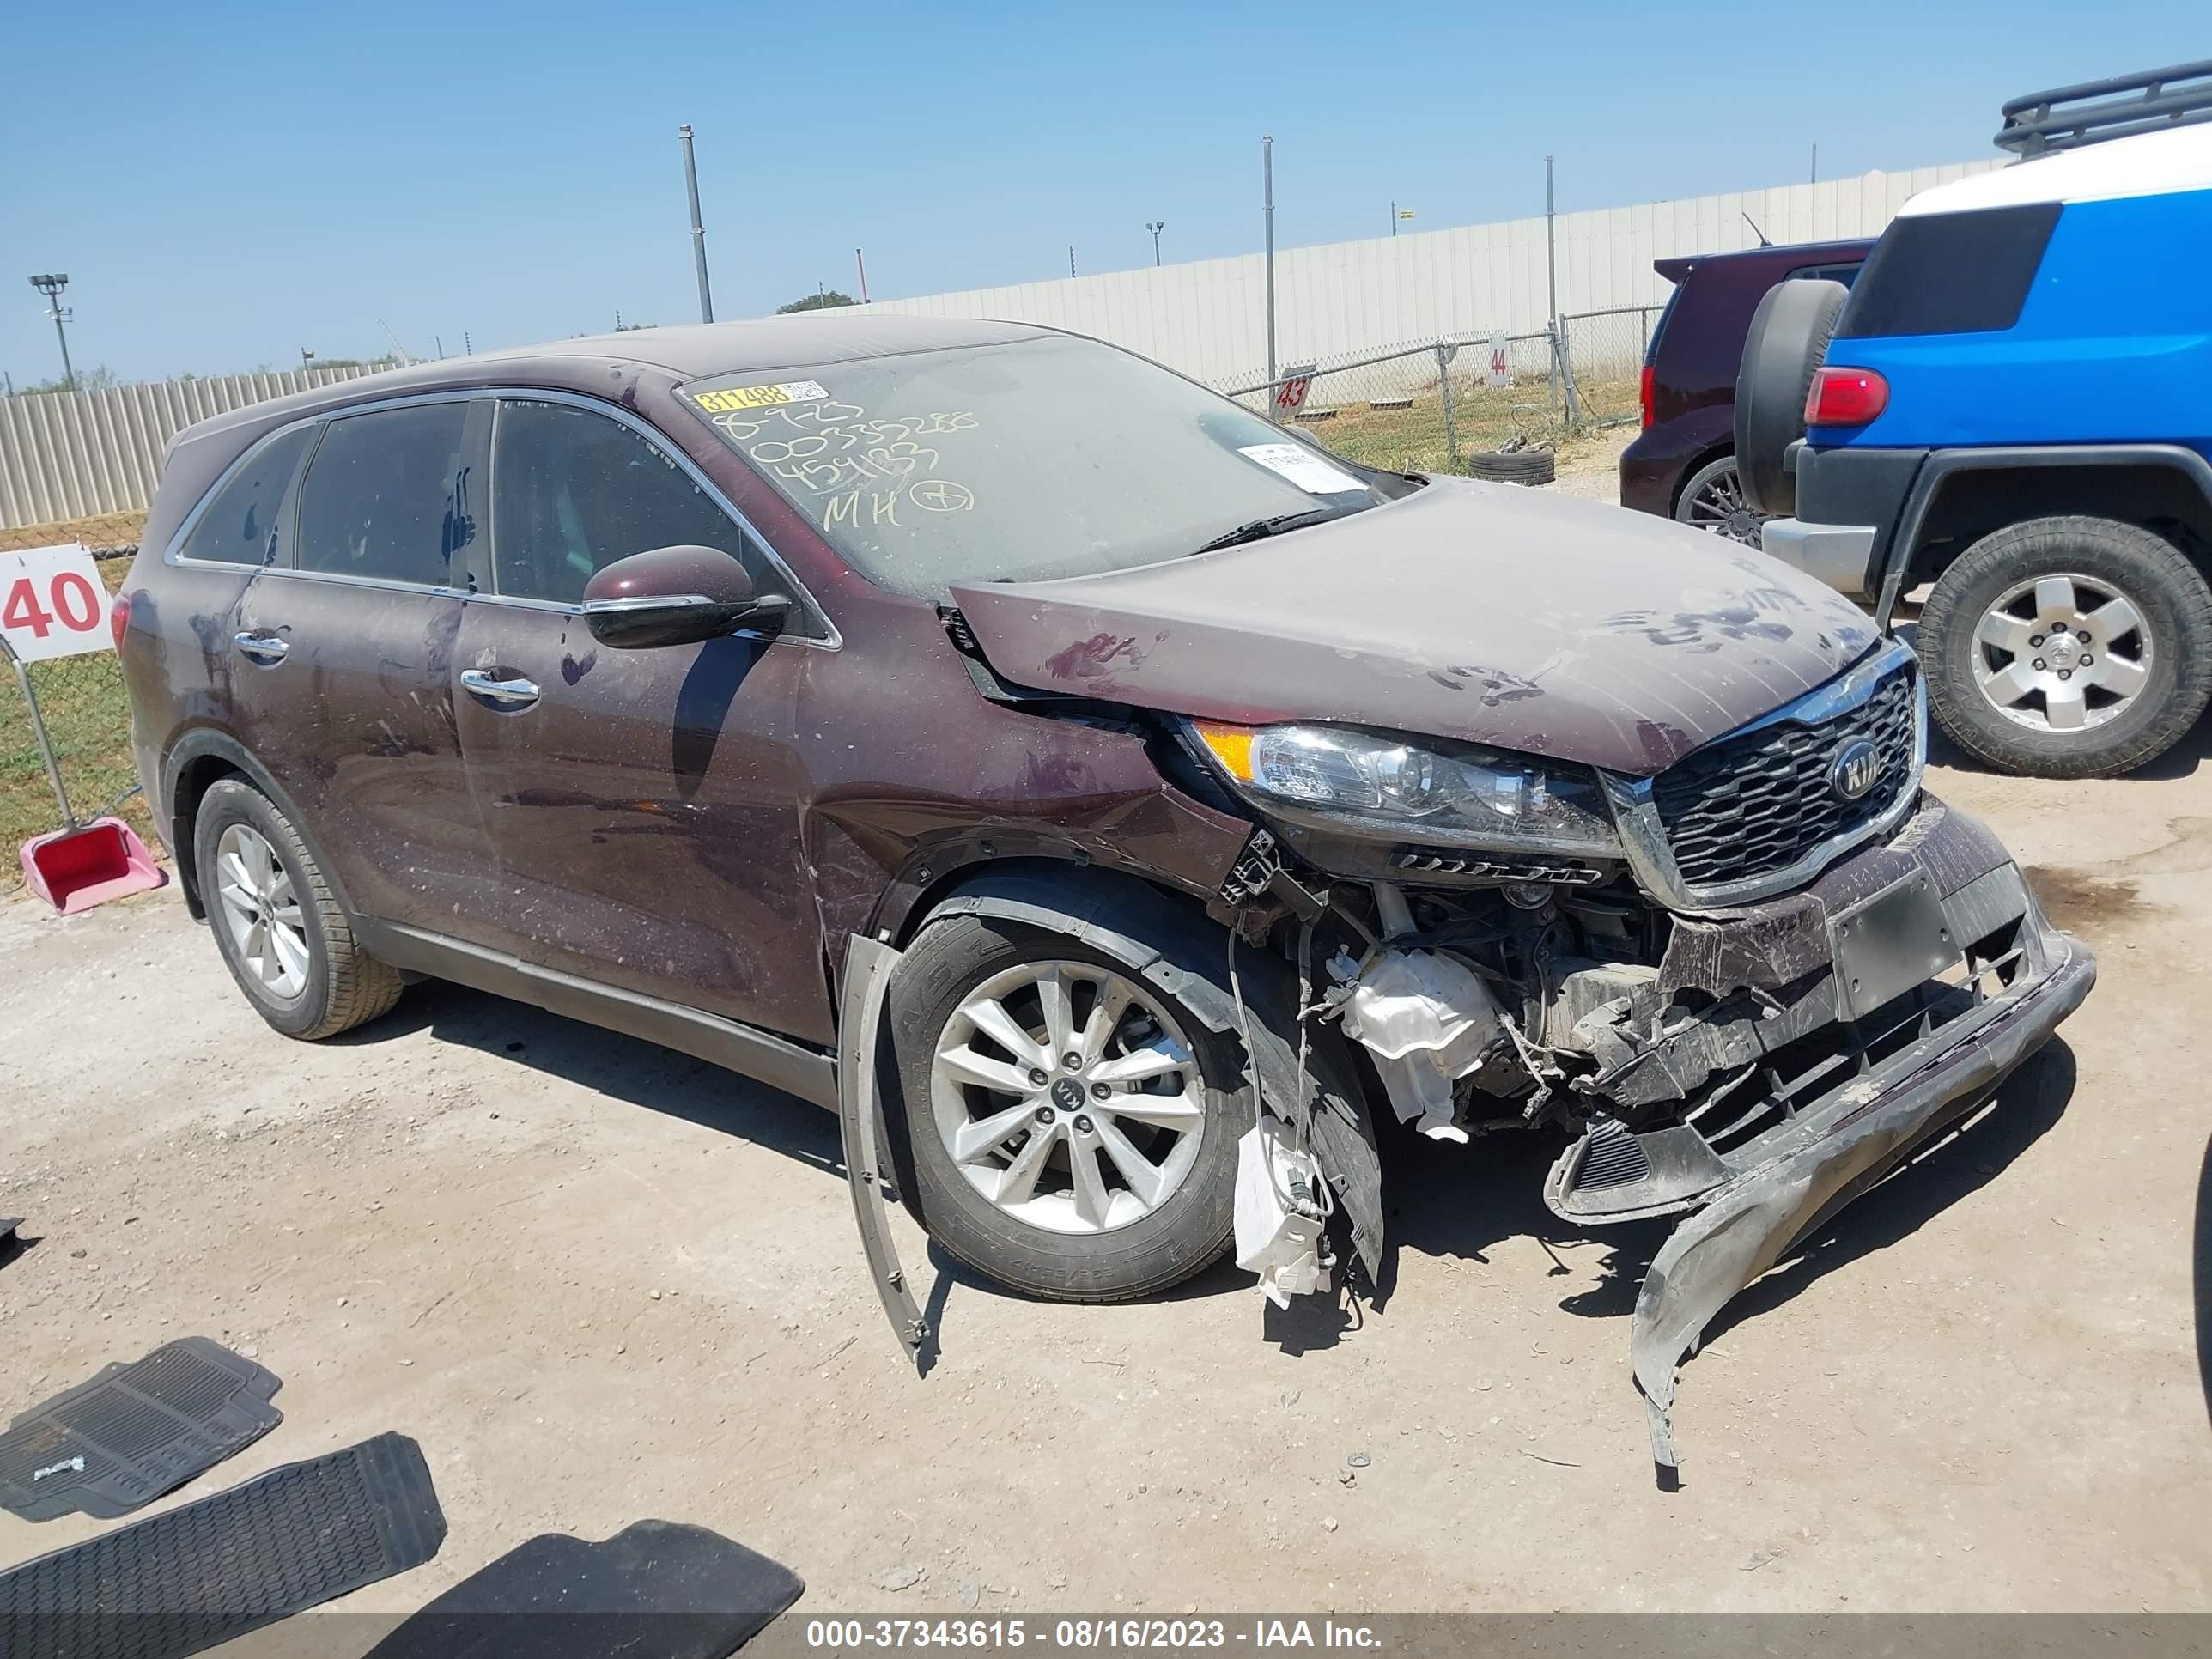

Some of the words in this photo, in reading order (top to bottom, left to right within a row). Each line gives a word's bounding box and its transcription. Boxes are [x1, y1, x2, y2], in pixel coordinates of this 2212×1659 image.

[1492, 349, 1505, 375] 44
[699, 386, 790, 411] 311488
[1277, 378, 1306, 408] 43
[3, 572, 100, 638] 40
[1845, 750, 1878, 792] KIA
[1057, 1082, 1080, 1109] KIA
